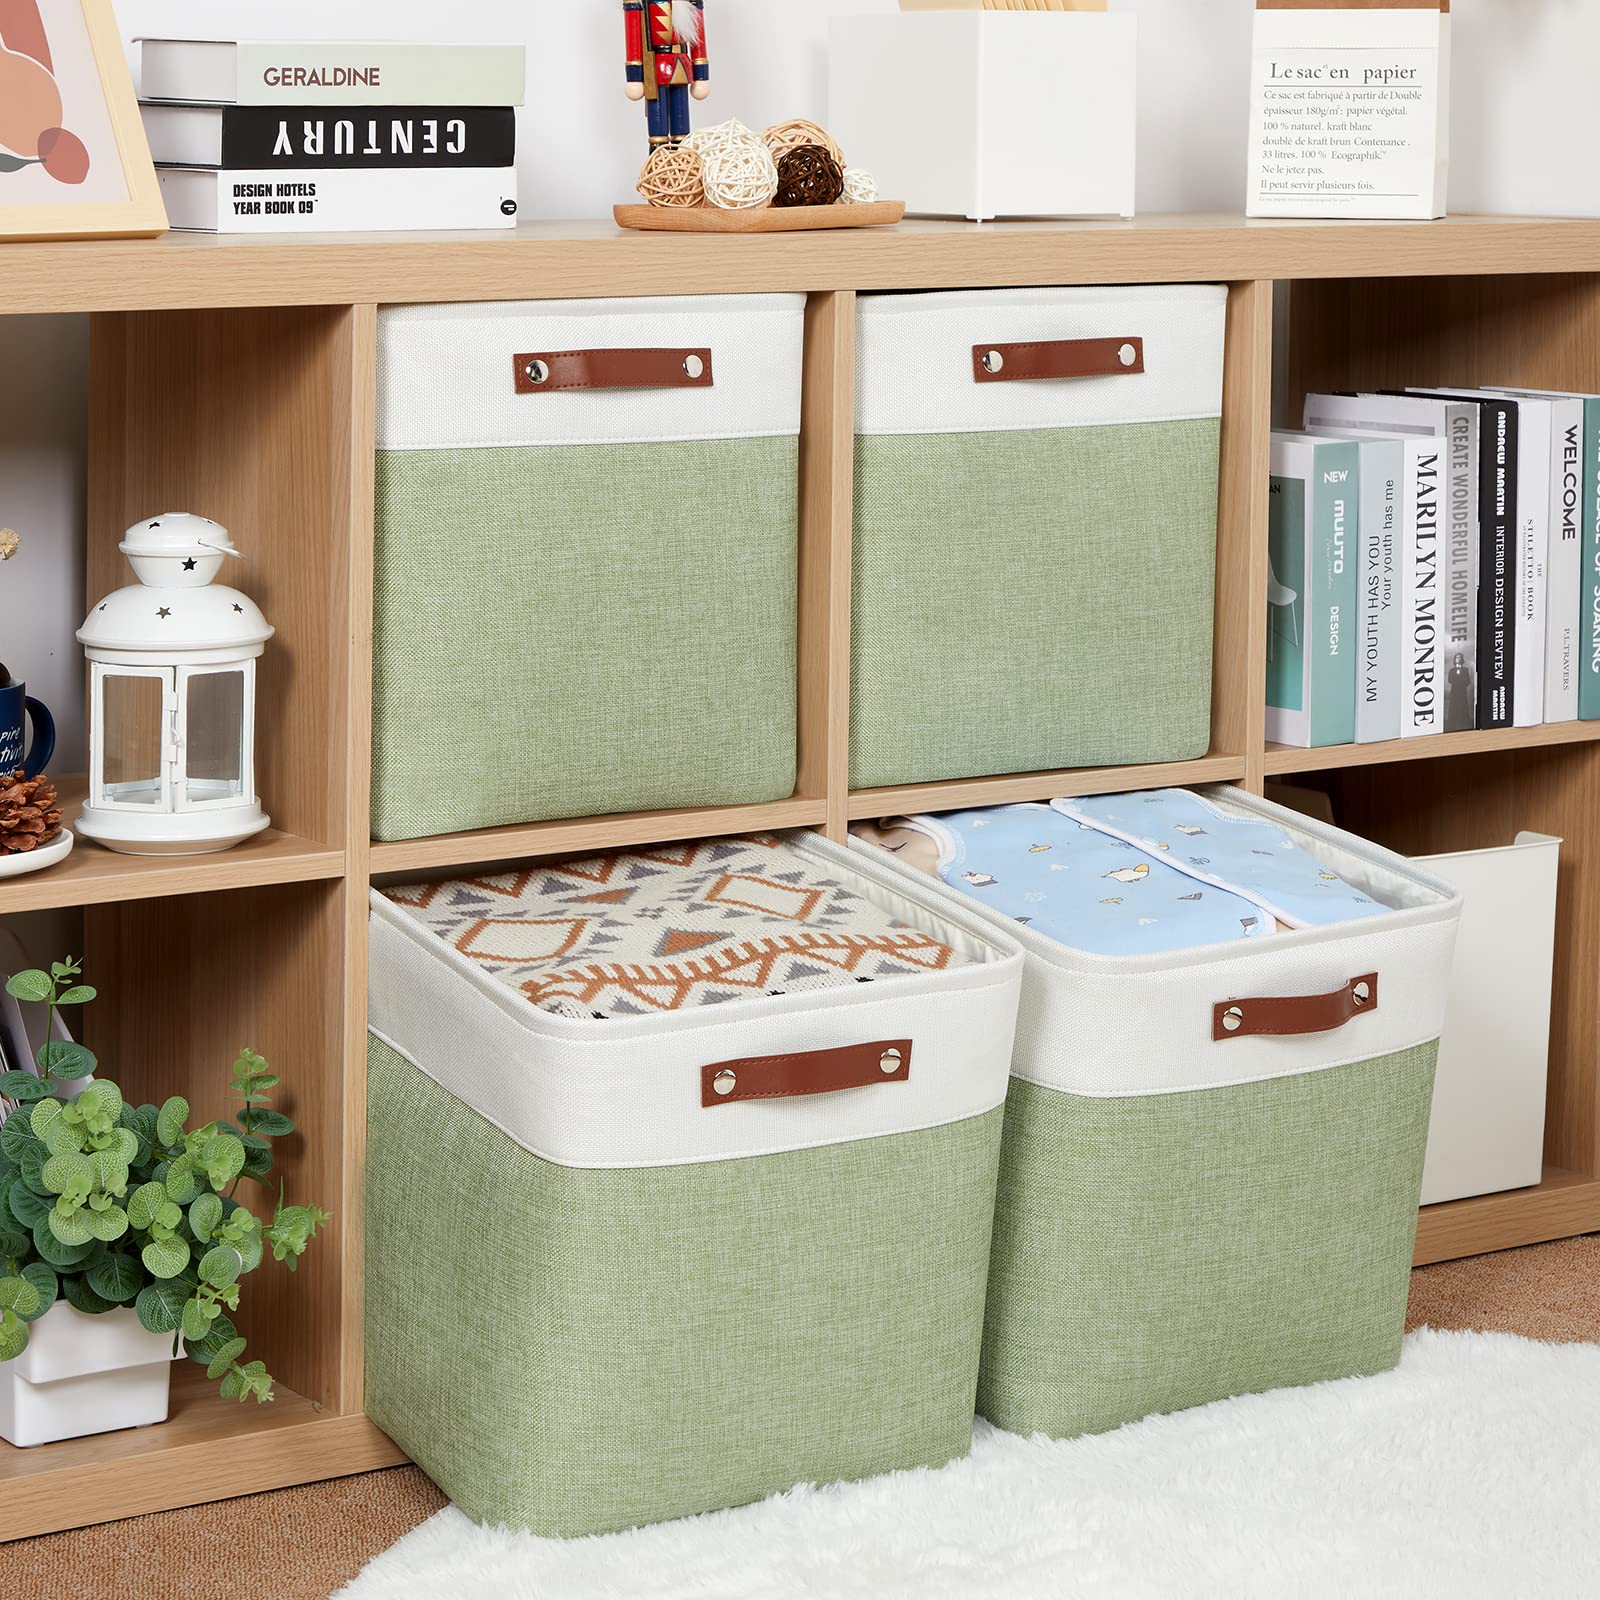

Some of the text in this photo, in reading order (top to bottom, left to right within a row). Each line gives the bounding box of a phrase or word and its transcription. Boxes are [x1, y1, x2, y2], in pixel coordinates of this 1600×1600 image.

[263, 67, 380, 87] GERALDINE
[1270, 62, 1416, 84] Le sac en papier
[1264, 90, 1276, 100] Ce
[1294, 92, 1305, 100] est
[1308, 90, 1344, 102] fabriqué
[1346, 91, 1350, 100] à
[1352, 91, 1376, 102] partir
[1378, 91, 1389, 100] de
[1390, 91, 1422, 100] Double
[1264, 106, 1304, 117] épaisseur
[1346, 106, 1374, 118] papier
[1264, 122, 1278, 130] 100
[1280, 122, 1289, 130] %
[1327, 122, 1348, 131] kraft
[1350, 122, 1372, 131] blanc
[272, 119, 466, 156] CENTURY
[1295, 137, 1306, 146] de
[1308, 137, 1328, 146] kraft
[1330, 137, 1351, 146] brun
[1262, 150, 1273, 159] 33
[1301, 150, 1316, 159] 100
[1318, 151, 1327, 159] %
[1262, 165, 1275, 174] Ne
[1276, 165, 1284, 174] le
[1286, 166, 1306, 176] jetez
[233, 183, 316, 197] DESIGN HOTELS
[1261, 180, 1267, 188] Il
[1269, 181, 1288, 191] peut
[1290, 181, 1315, 190] servir
[1316, 181, 1356, 191] plusieurs
[233, 202, 261, 215] YEAR
[265, 201, 295, 214] BOOK
[1496, 411, 1506, 516] ANDREW MARTIN
[1324, 470, 1348, 483] NEW
[1562, 424, 1578, 540] WELCOME
[1451, 416, 1469, 642] CREATE WONDERFUL HOMELIFE
[1381, 480, 1394, 610] Your youth has me
[1495, 526, 1505, 575] INTERIOR
[1413, 453, 1438, 726] MARILYN MONROE
[1495, 579, 1504, 627] DESIGN
[1366, 536, 1380, 702] MY YOUTH HAS YOU
[1330, 606, 1339, 656] DESIGN
